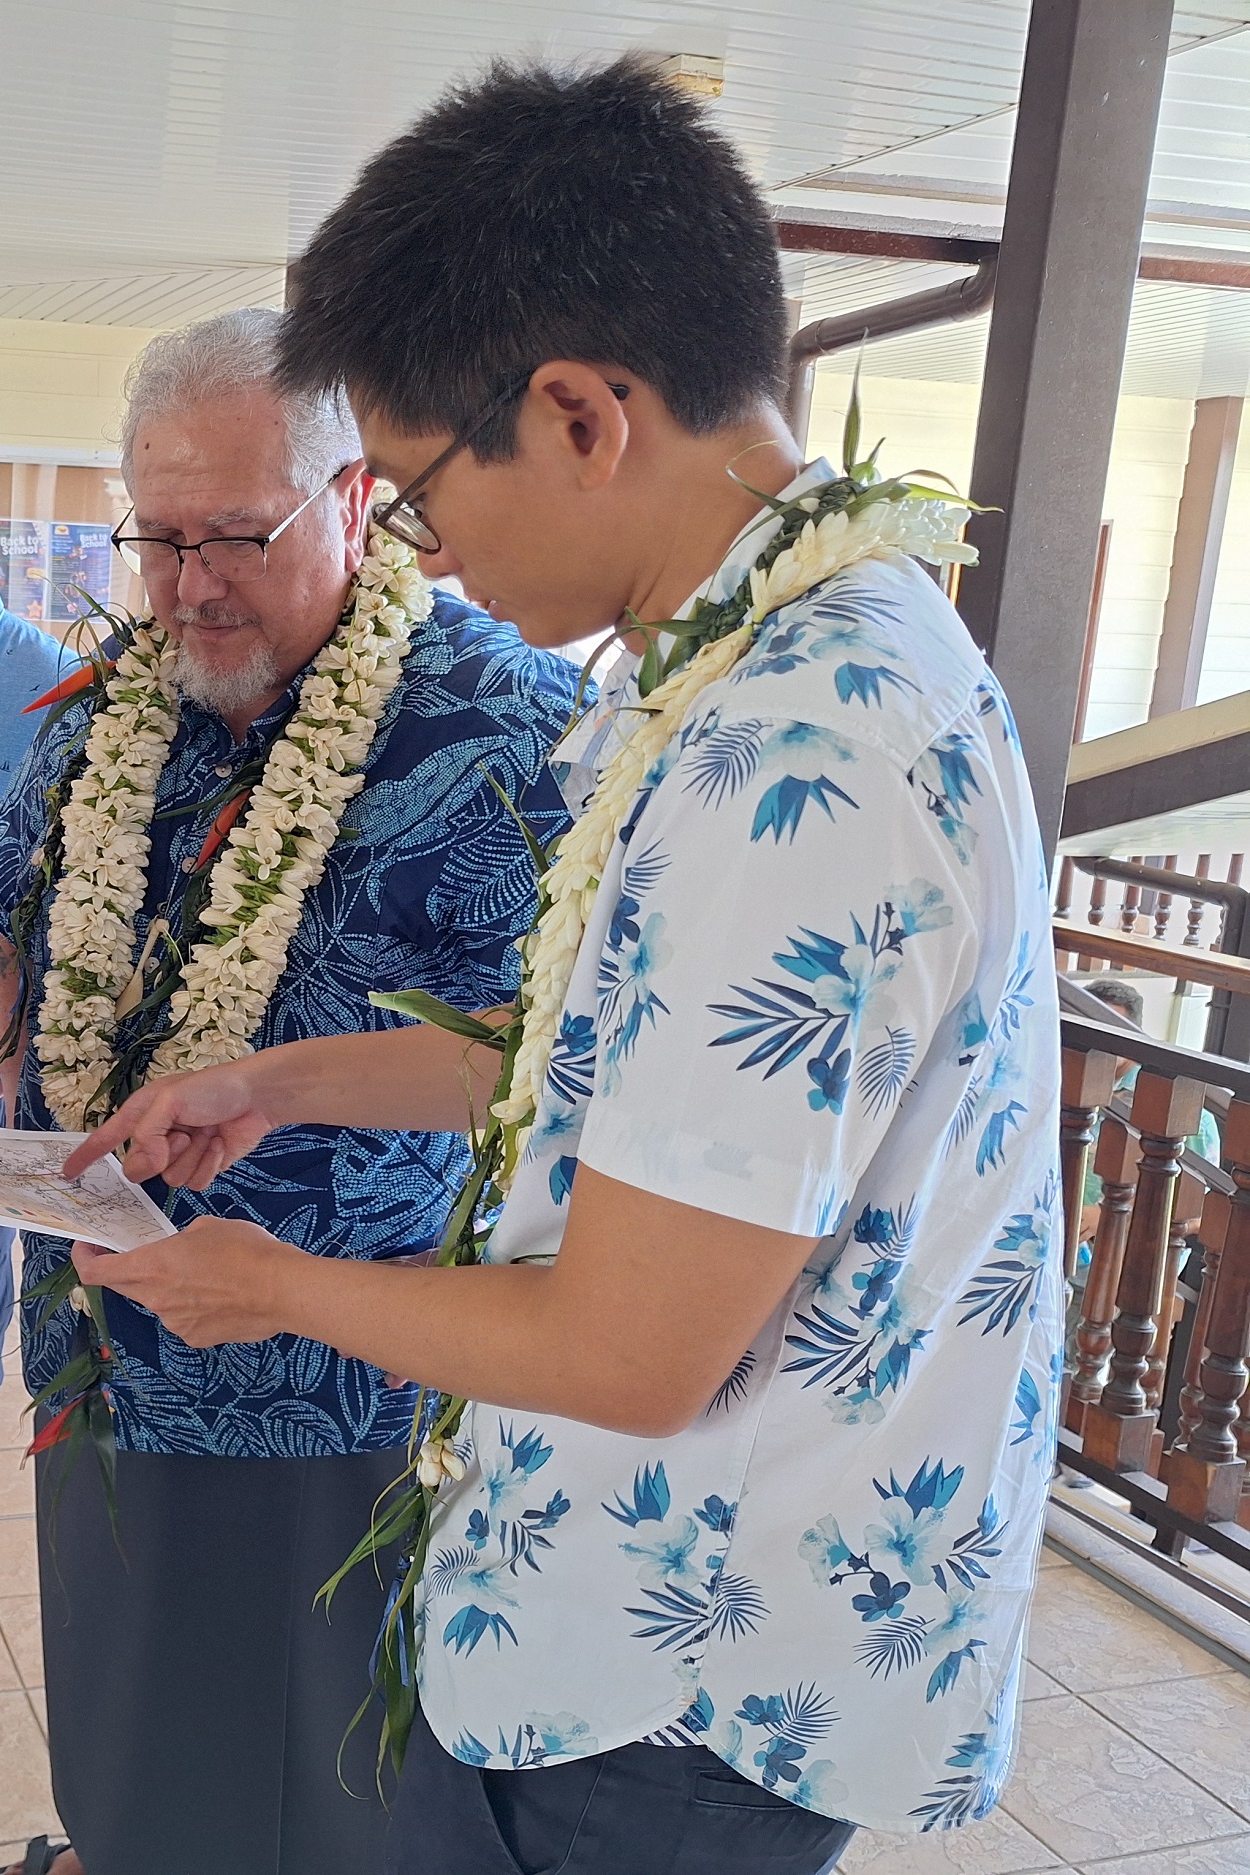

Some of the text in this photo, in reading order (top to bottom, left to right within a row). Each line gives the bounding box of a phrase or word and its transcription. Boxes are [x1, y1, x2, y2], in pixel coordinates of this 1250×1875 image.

[0, 536, 26, 547] Back
[27, 535, 39, 546] to
[79, 533, 108, 542] Back to
[81, 540, 107, 548] School
[2, 545, 38, 555] School
